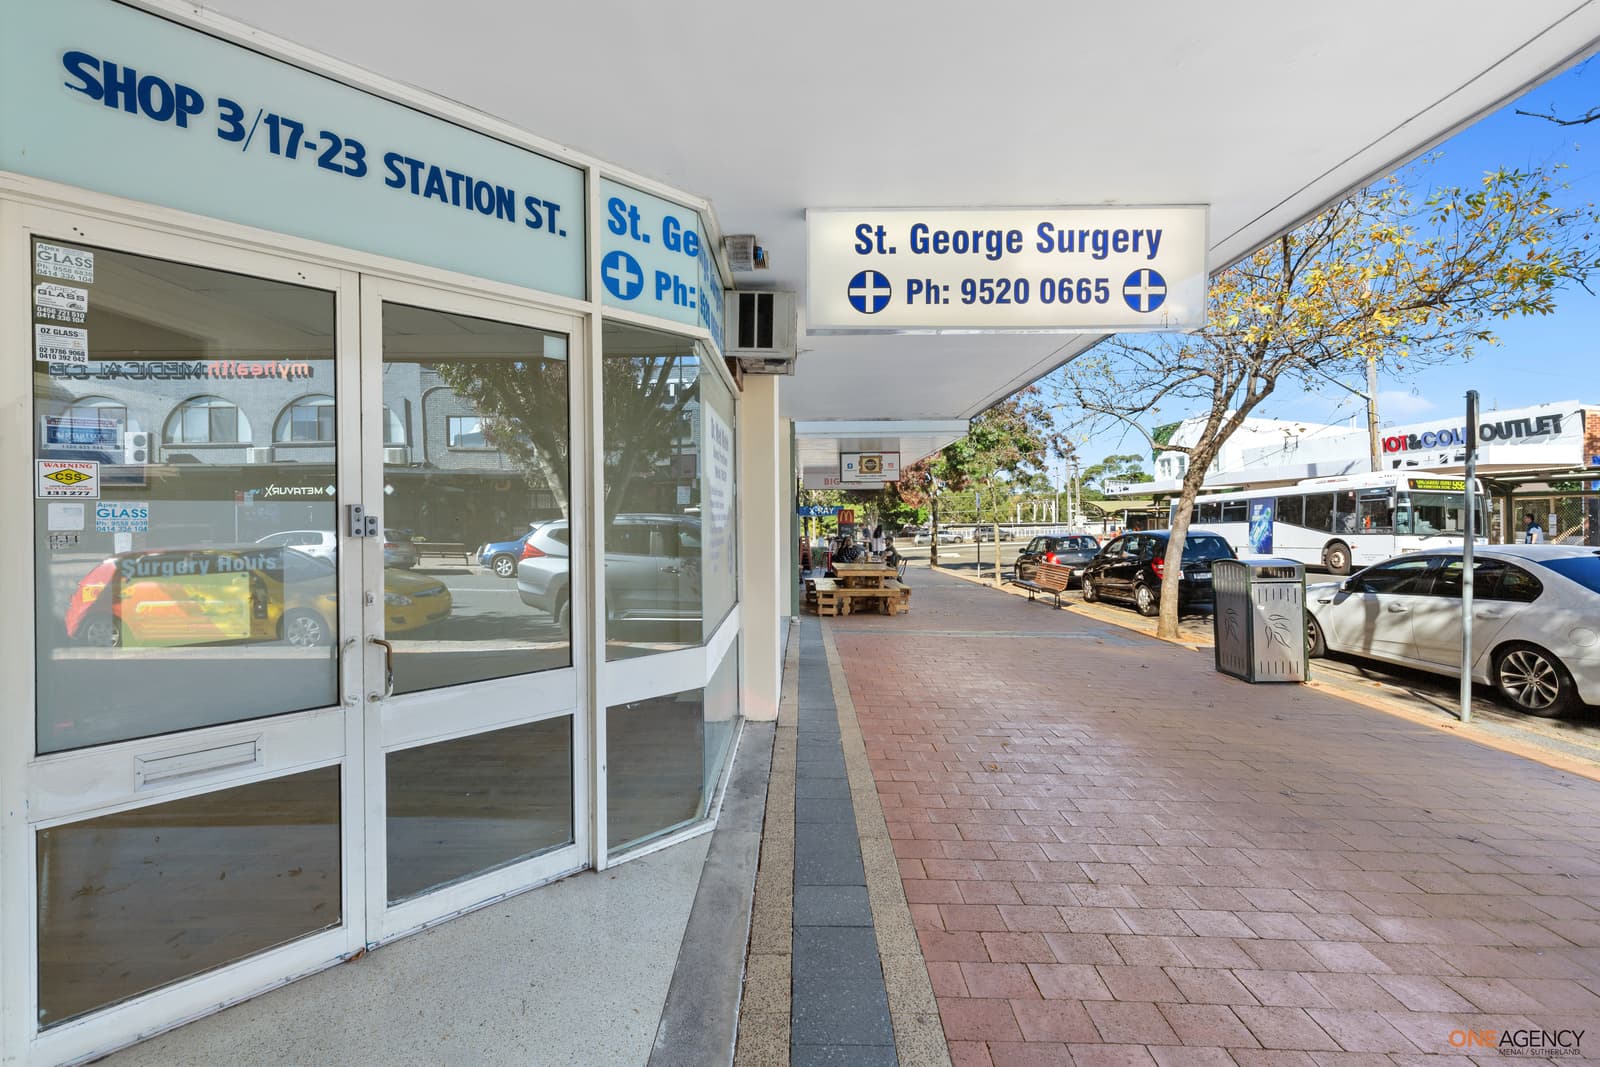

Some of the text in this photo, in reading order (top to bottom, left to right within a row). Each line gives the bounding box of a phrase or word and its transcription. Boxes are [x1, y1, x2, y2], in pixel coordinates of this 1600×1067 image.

[62, 50, 567, 238] SHOP 3/17-23 STATION ST.
[607, 197, 651, 244] St.
[854, 222, 1163, 261] St. George Surgery
[38, 251, 92, 268] GLASS
[38, 289, 85, 301] GLASS
[46, 285, 77, 294] APEX
[655, 270, 696, 309] Ph:
[906, 277, 1110, 305] Ph: 9520 0665
[53, 329, 79, 337] GLASS
[1479, 414, 1564, 442] OUTLET
[43, 462, 93, 470] WARNING
[55, 472, 83, 481] CSS
[96, 508, 148, 518] GLASS
[121, 555, 277, 578] Surgery Hours
